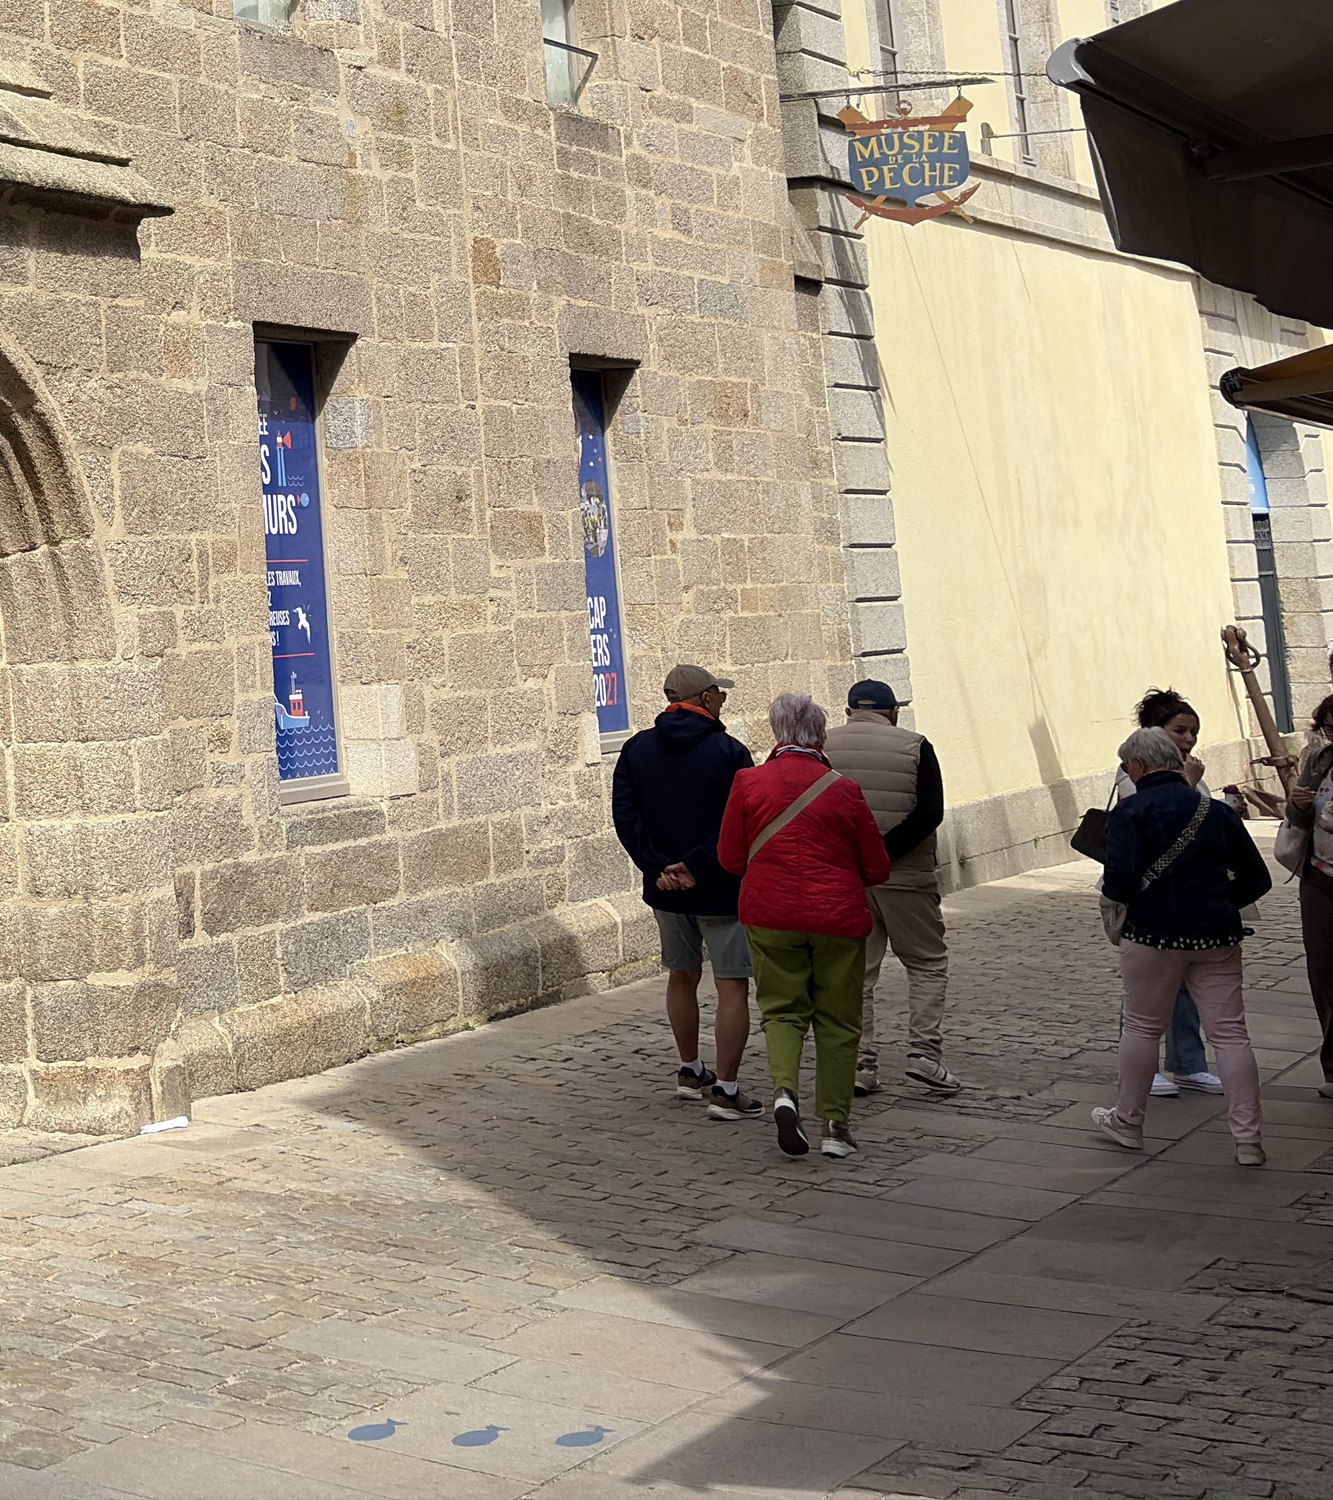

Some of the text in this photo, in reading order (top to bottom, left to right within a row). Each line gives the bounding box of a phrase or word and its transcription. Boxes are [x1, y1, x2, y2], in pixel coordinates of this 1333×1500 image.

[853, 131, 961, 162] MUSEE
[889, 153, 929, 164] DE LA
[859, 163, 961, 191] PECHE
[275, 570, 302, 588] TRAVAUX,
[269, 610, 290, 627] REUSES
[587, 596, 607, 630] CAP
[590, 633, 611, 667] ERS
[593, 672, 618, 707] 2027
